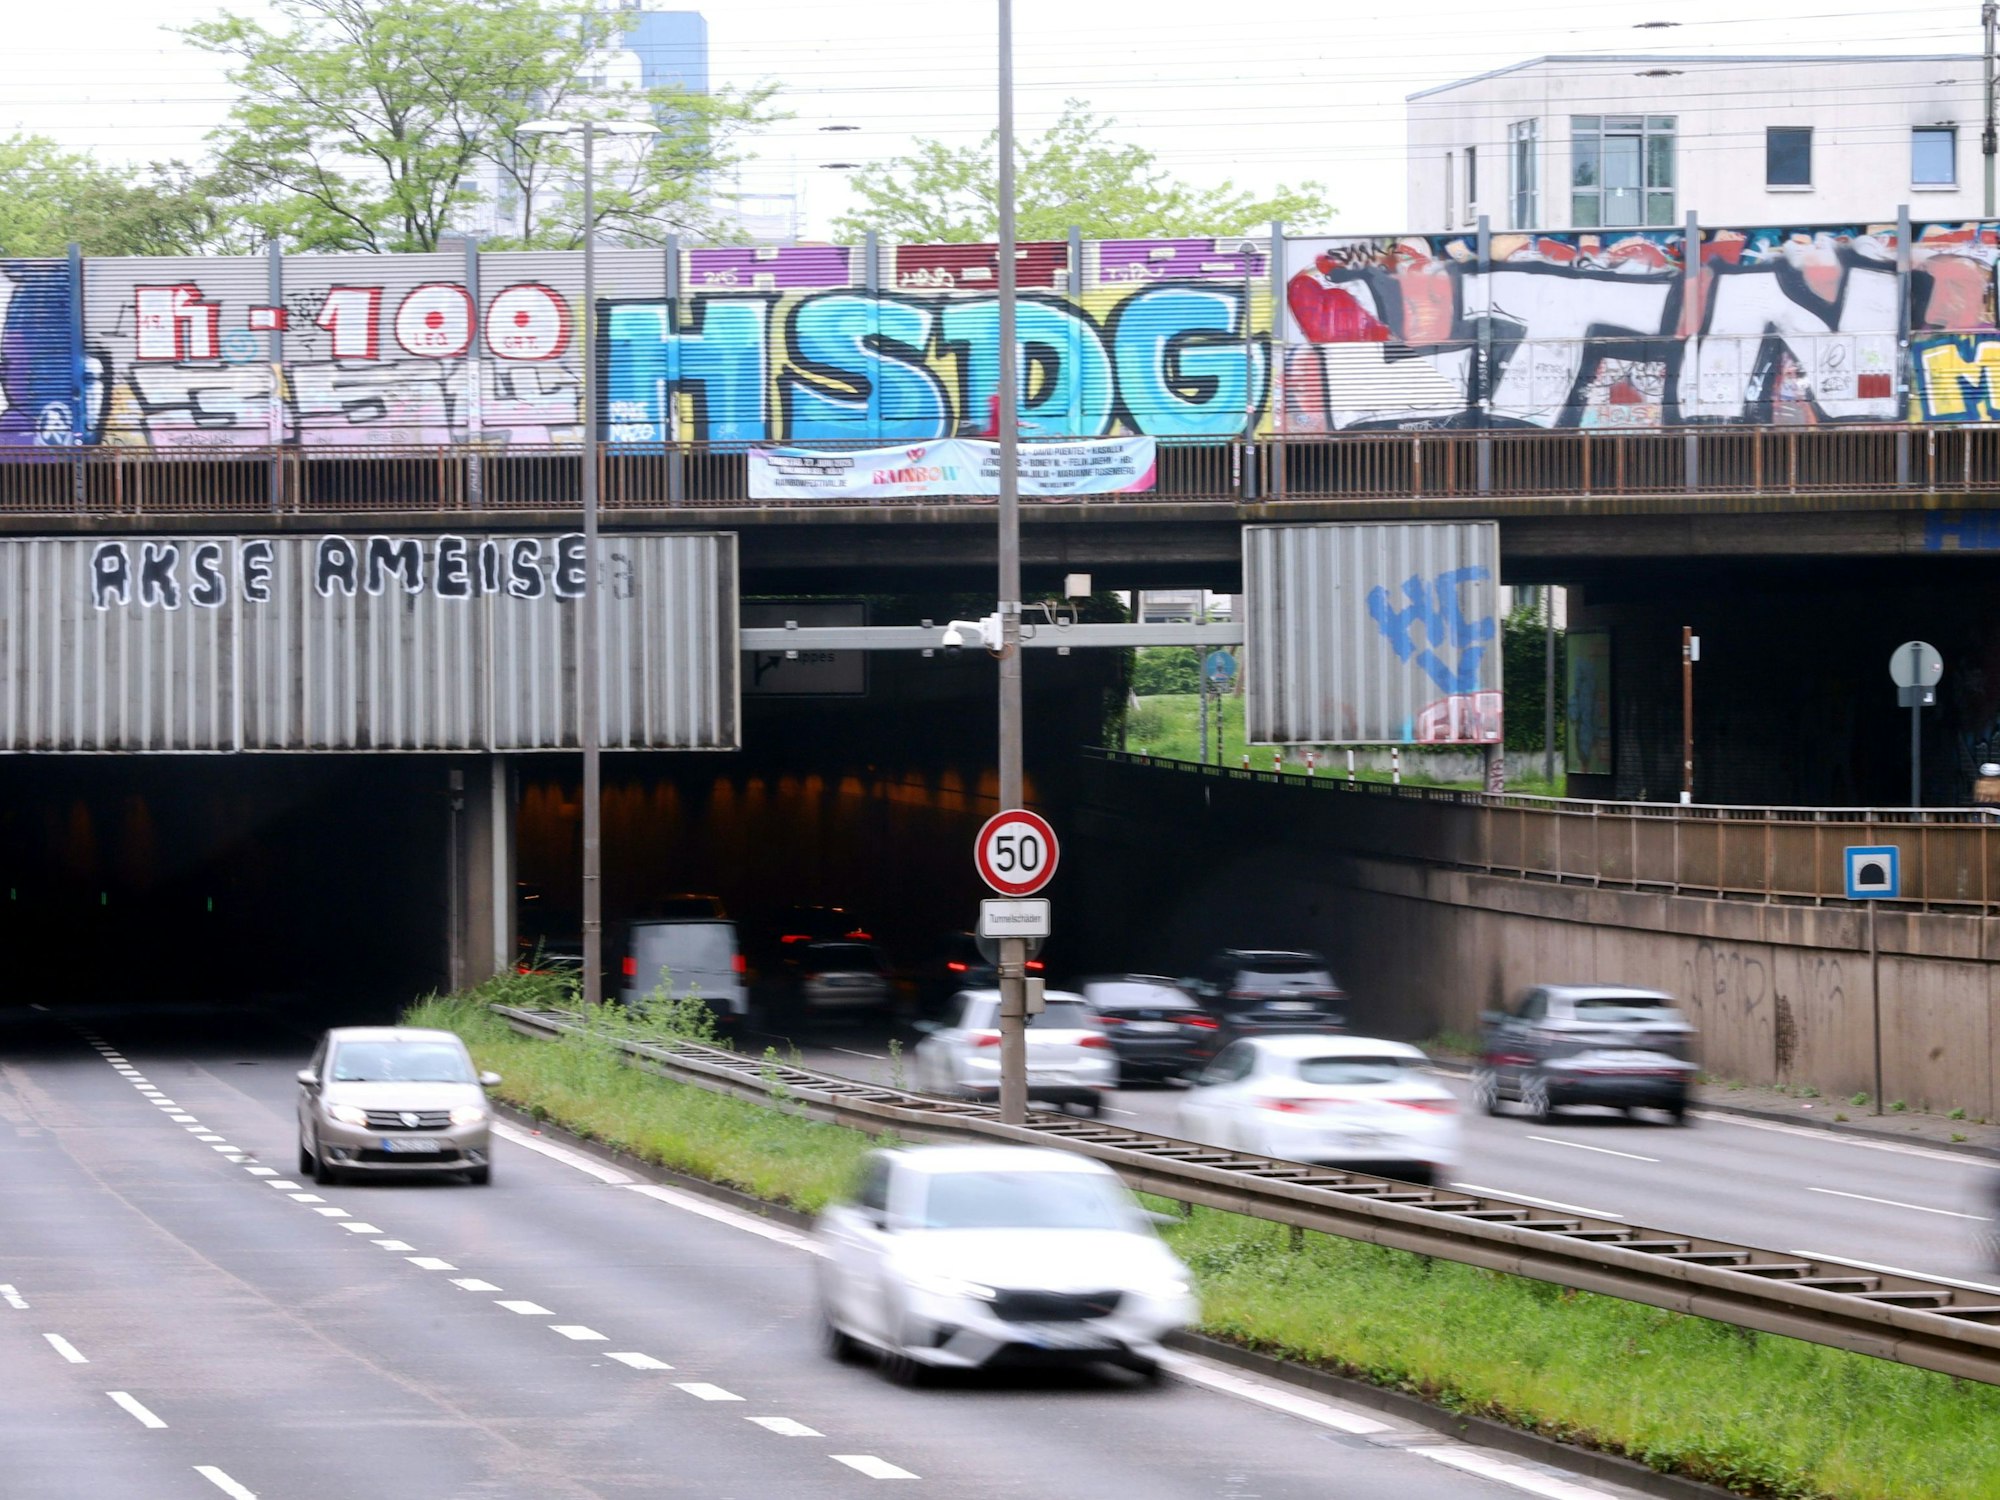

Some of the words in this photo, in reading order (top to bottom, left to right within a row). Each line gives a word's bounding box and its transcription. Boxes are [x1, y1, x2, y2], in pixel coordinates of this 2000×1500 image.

[873, 465, 960, 485] RAINBOW
[91, 537, 275, 612] AKSE
[315, 533, 588, 601] AMEISE
[996, 835, 1038, 872] 50
[989, 912, 1042, 923] Tunnelschäden
